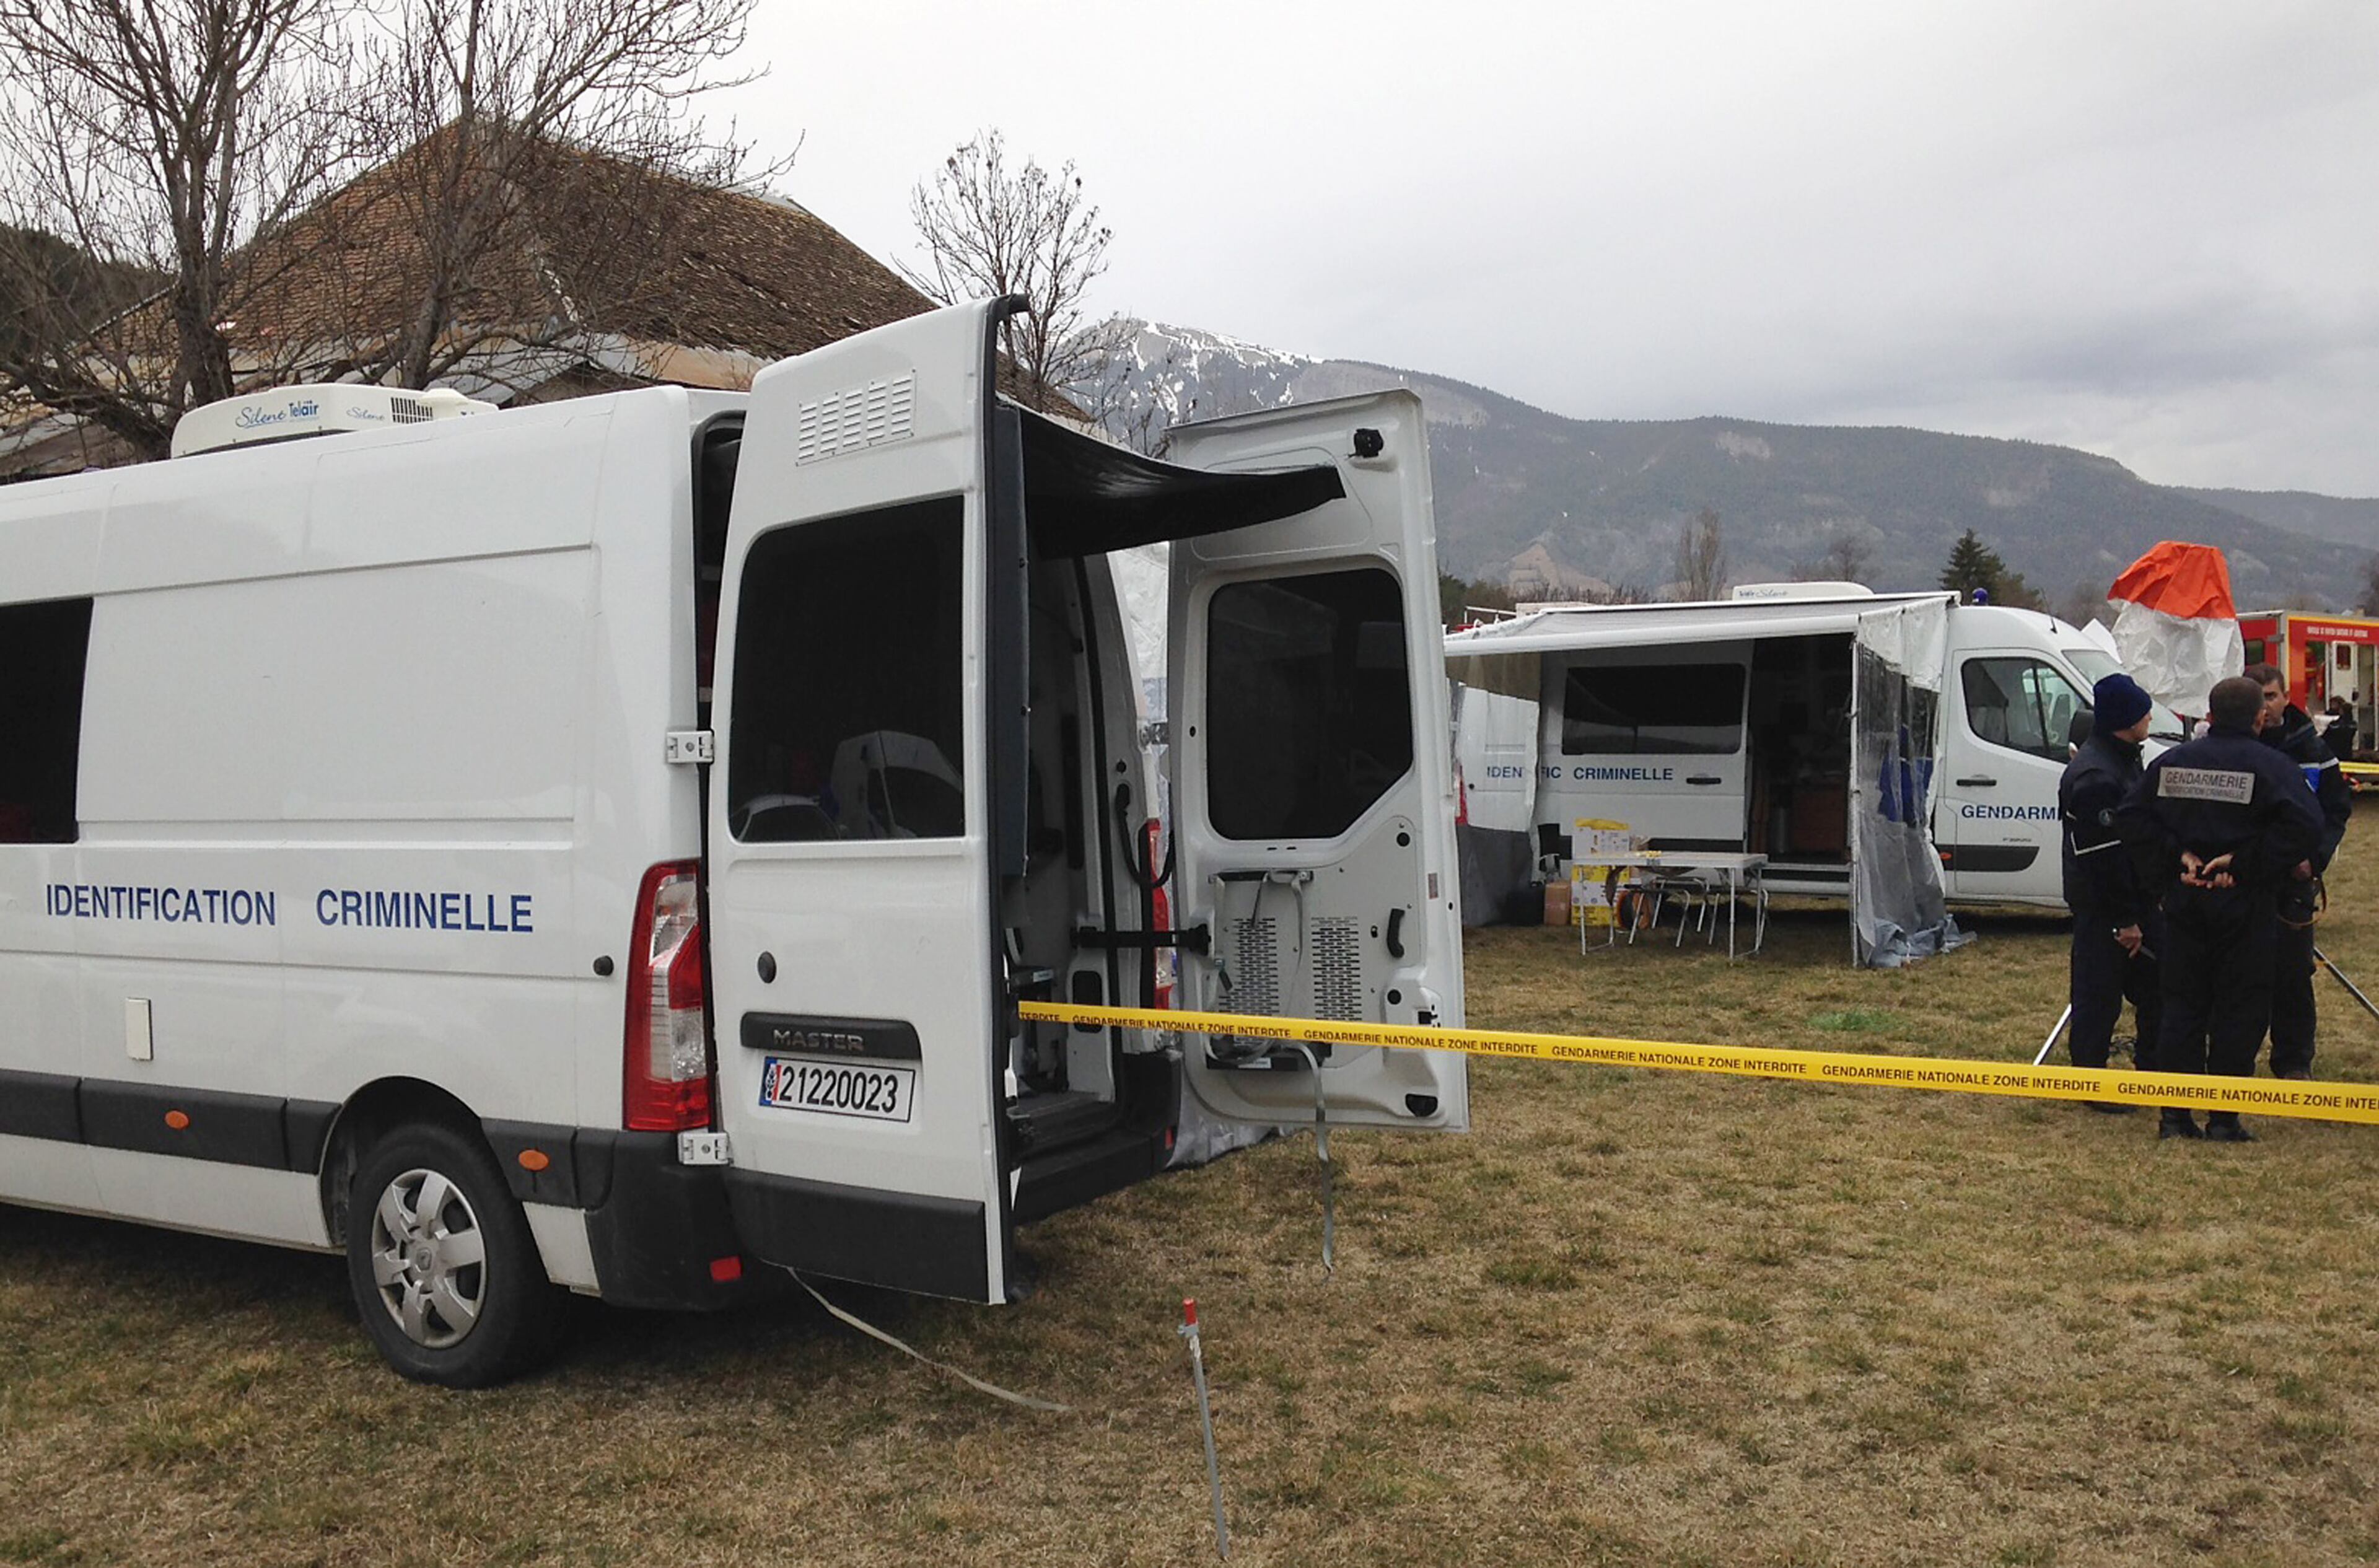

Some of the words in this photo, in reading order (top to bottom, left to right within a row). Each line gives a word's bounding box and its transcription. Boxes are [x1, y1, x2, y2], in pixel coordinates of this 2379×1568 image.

[1573, 767, 1673, 781] CRIMINELLE
[2165, 771, 2248, 789] GENDARMERIE
[1961, 804, 2062, 821] GENDARM
[46, 883, 276, 926] IDENTIFICATION
[315, 888, 534, 933] CRIMINELLE
[1072, 1015, 1145, 1027] GENDARMERIE
[1147, 1020, 1204, 1031] NATIONALE
[1207, 1023, 1235, 1034] ZONE
[1238, 1026, 1291, 1038] INTERDITE
[774, 1029, 864, 1051] MASTER
[1303, 1030, 1382, 1043] GENDARMERIE
[1384, 1035, 1445, 1048] NATIONALE
[1448, 1039, 1478, 1050] ZONE
[1480, 1041, 1538, 1054] INTERDITE
[1551, 1046, 1636, 1061] GENDARMERIE
[1639, 1053, 1704, 1067] NATIONALE
[1708, 1057, 1741, 1069] ZONE
[1744, 1060, 1807, 1073] INTERDITE
[779, 1065, 899, 1113] 21220023
[1822, 1064, 1914, 1081] GENDARMERIE
[1917, 1070, 1990, 1085] NATIONALE
[1993, 1075, 2029, 1088] ZONE
[2032, 1077, 2101, 1092] INTERDITE
[2118, 1082, 2217, 1100] GENDARMERIE
[2221, 1089, 2299, 1105] NATIONALE
[2303, 1093, 2341, 1108] ZONE
[2346, 1097, 2379, 1110] INTE
